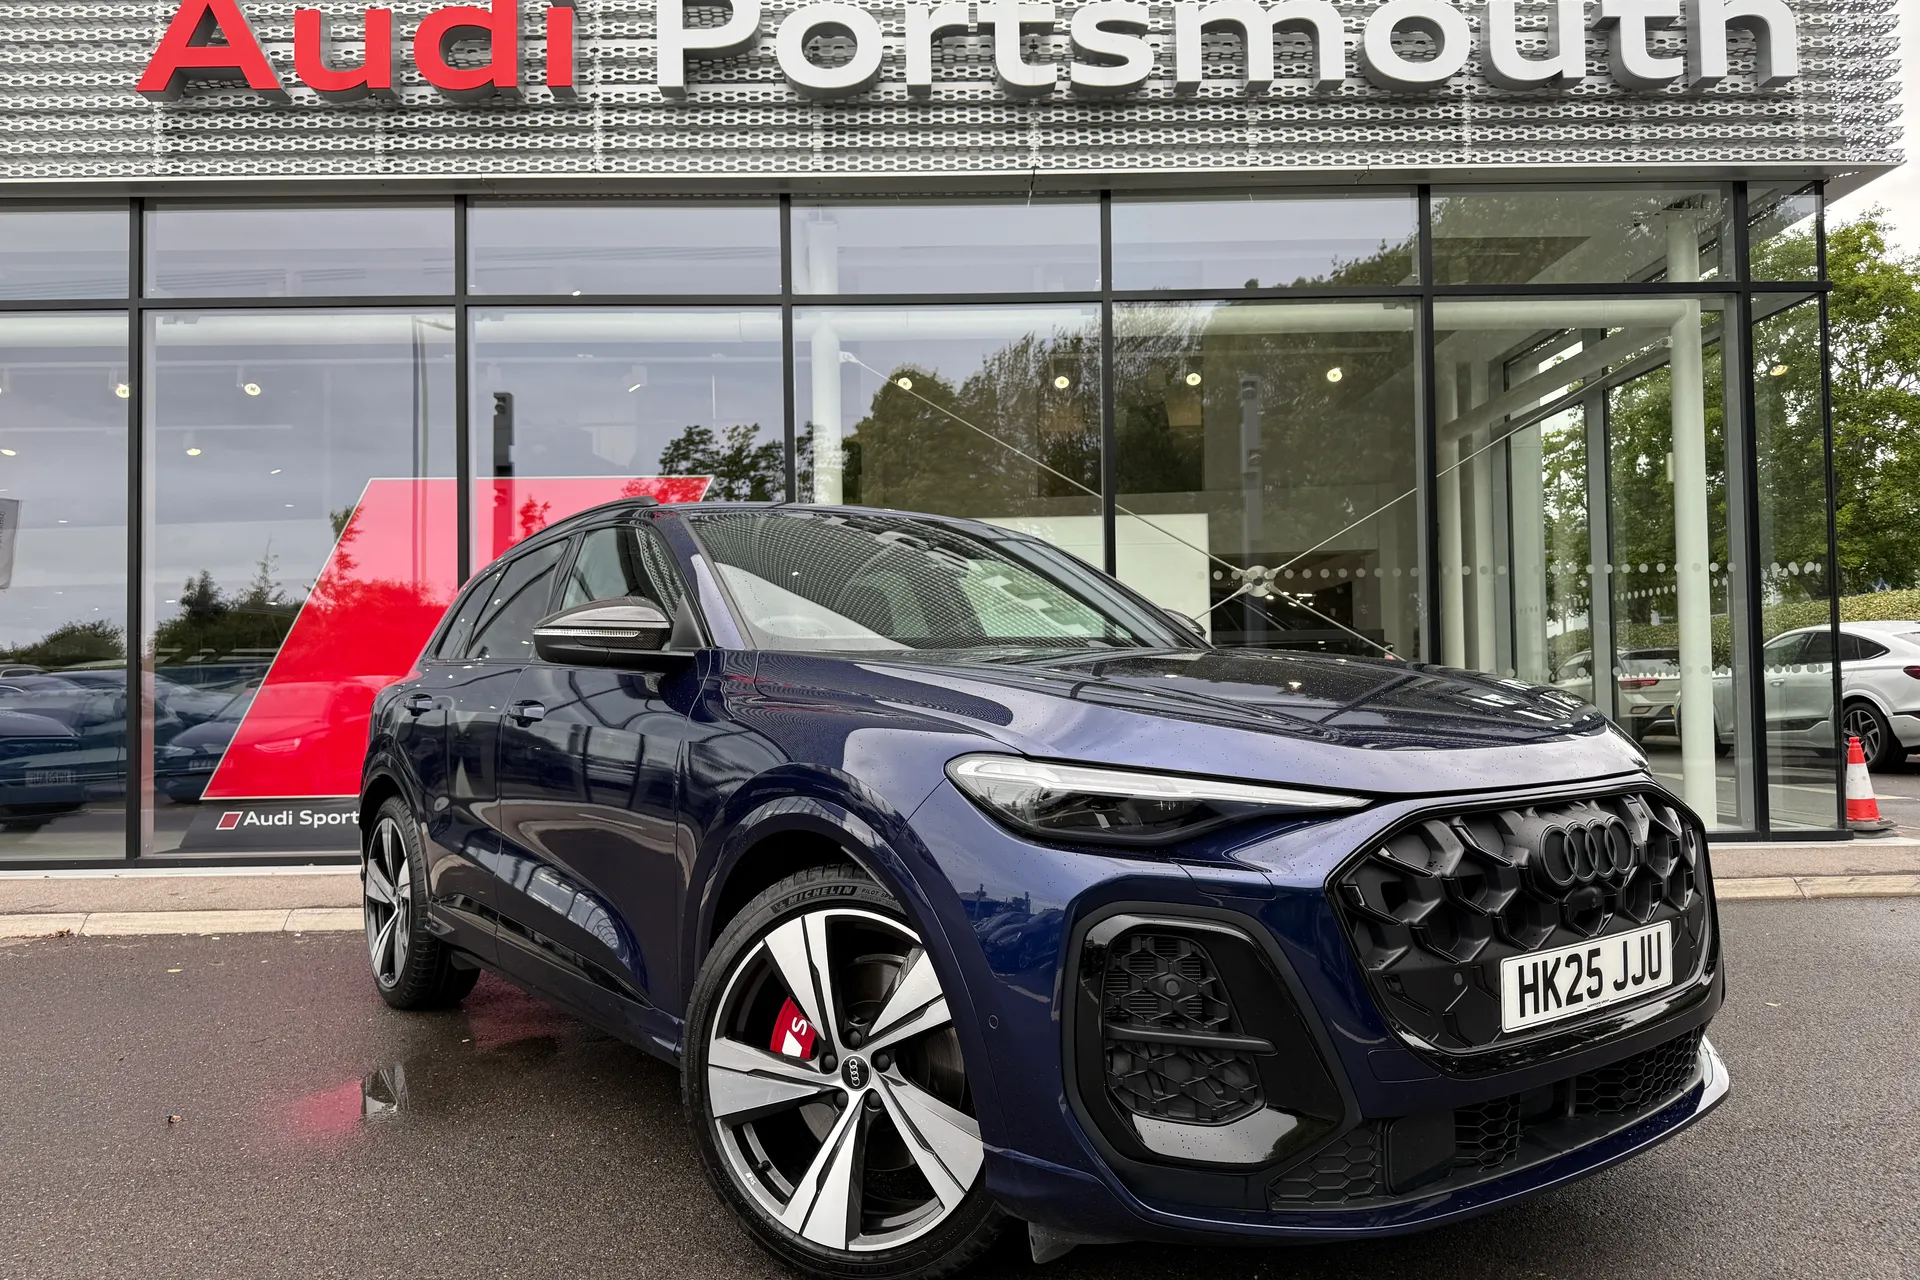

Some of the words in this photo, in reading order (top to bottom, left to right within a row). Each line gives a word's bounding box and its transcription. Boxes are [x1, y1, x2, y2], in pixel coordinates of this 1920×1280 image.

[136, 0, 573, 93] Audi
[656, 0, 1798, 91] Portsmouth
[243, 811, 293, 826] Audi
[299, 810, 359, 828] Sport
[788, 886, 853, 905] MICHELIN
[1519, 949, 1603, 1018] HK25
[1613, 932, 1662, 992] JJU
[791, 1016, 807, 1035] S
